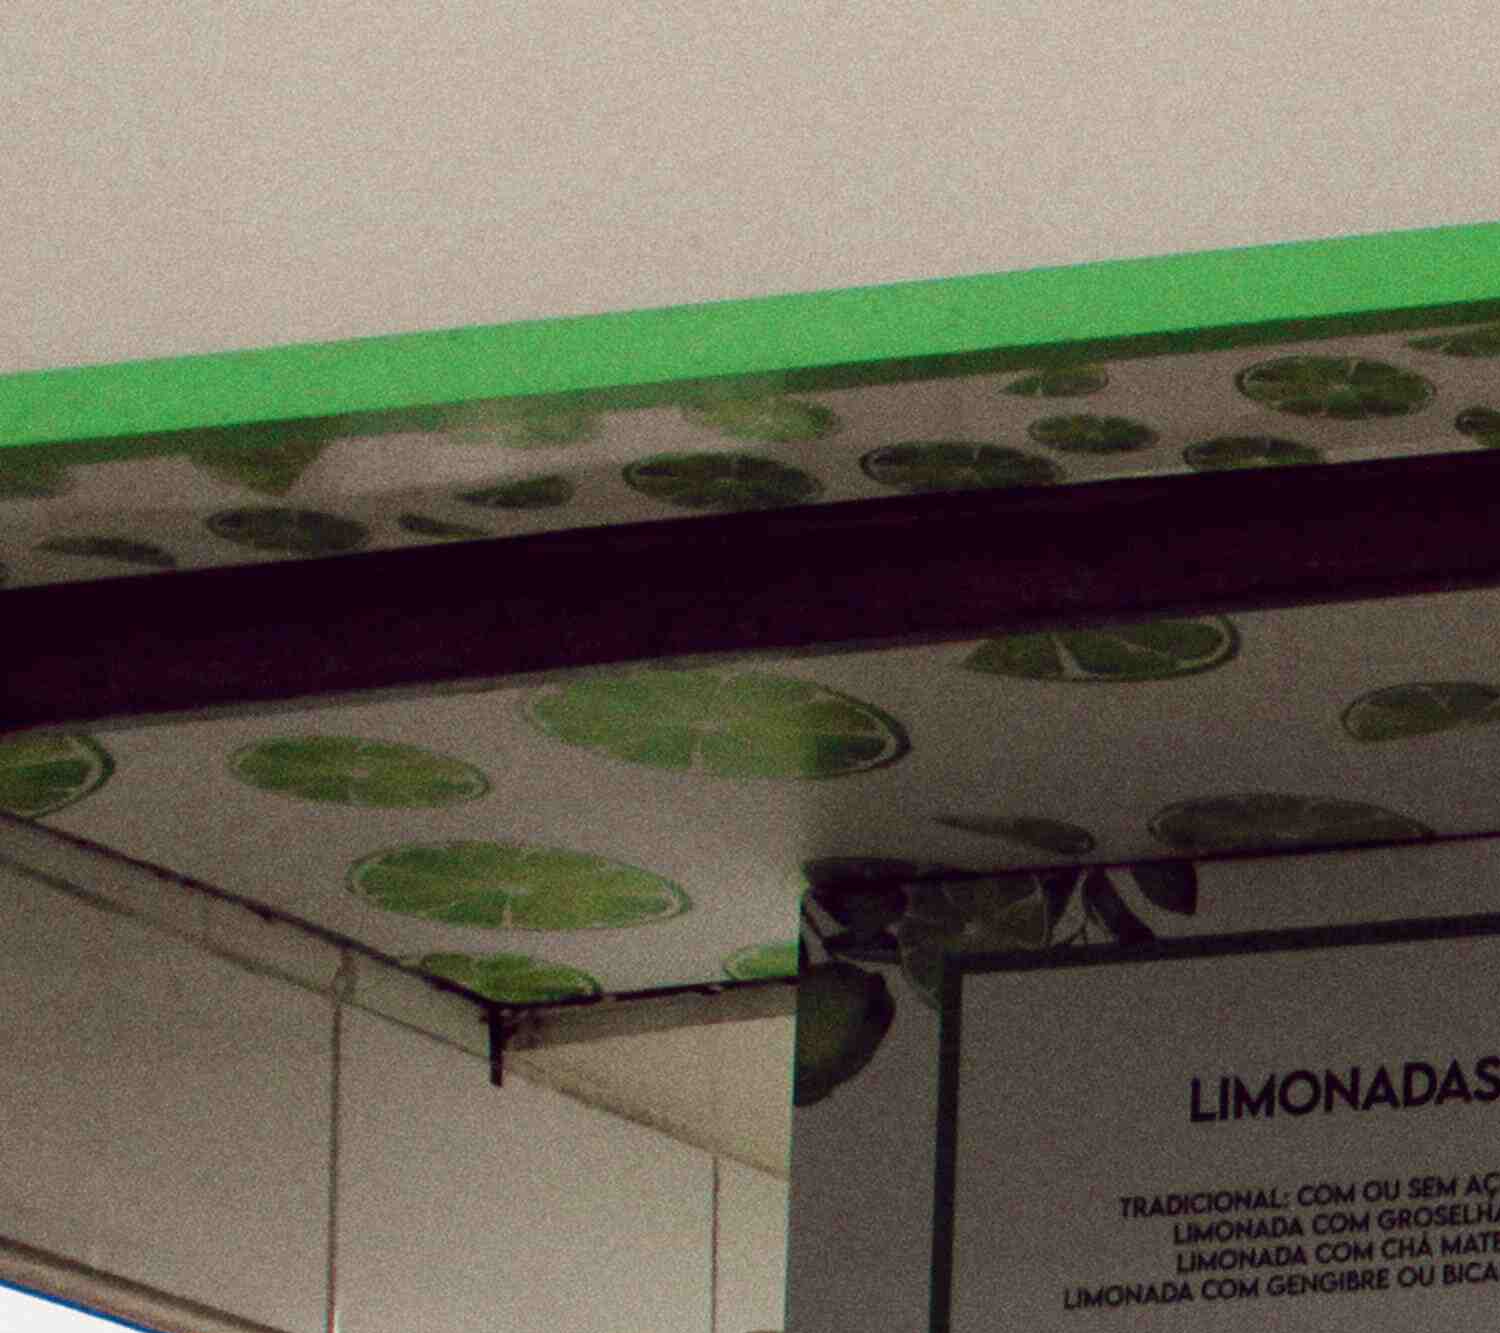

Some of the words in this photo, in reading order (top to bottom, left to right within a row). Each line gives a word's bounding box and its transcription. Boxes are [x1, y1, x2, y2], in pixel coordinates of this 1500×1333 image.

[1119, 1187, 1289, 1219] TRADICIONAL:
[1296, 1182, 1356, 1207] COM
[1362, 1179, 1401, 1202] OU
[1408, 1175, 1459, 1198] SEM
[1172, 1216, 1304, 1246] LIMONADA
[1312, 1212, 1370, 1236] COM
[1175, 1245, 1307, 1275] LIMONADA
[1315, 1242, 1374, 1264] COM
[1381, 1236, 1432, 1260] CHÁ
[1063, 1281, 1195, 1311] LIMONADA
[1200, 1278, 1260, 1302] COM
[1266, 1268, 1390, 1298] GENGIBRE
[1397, 1266, 1435, 1289] OU
